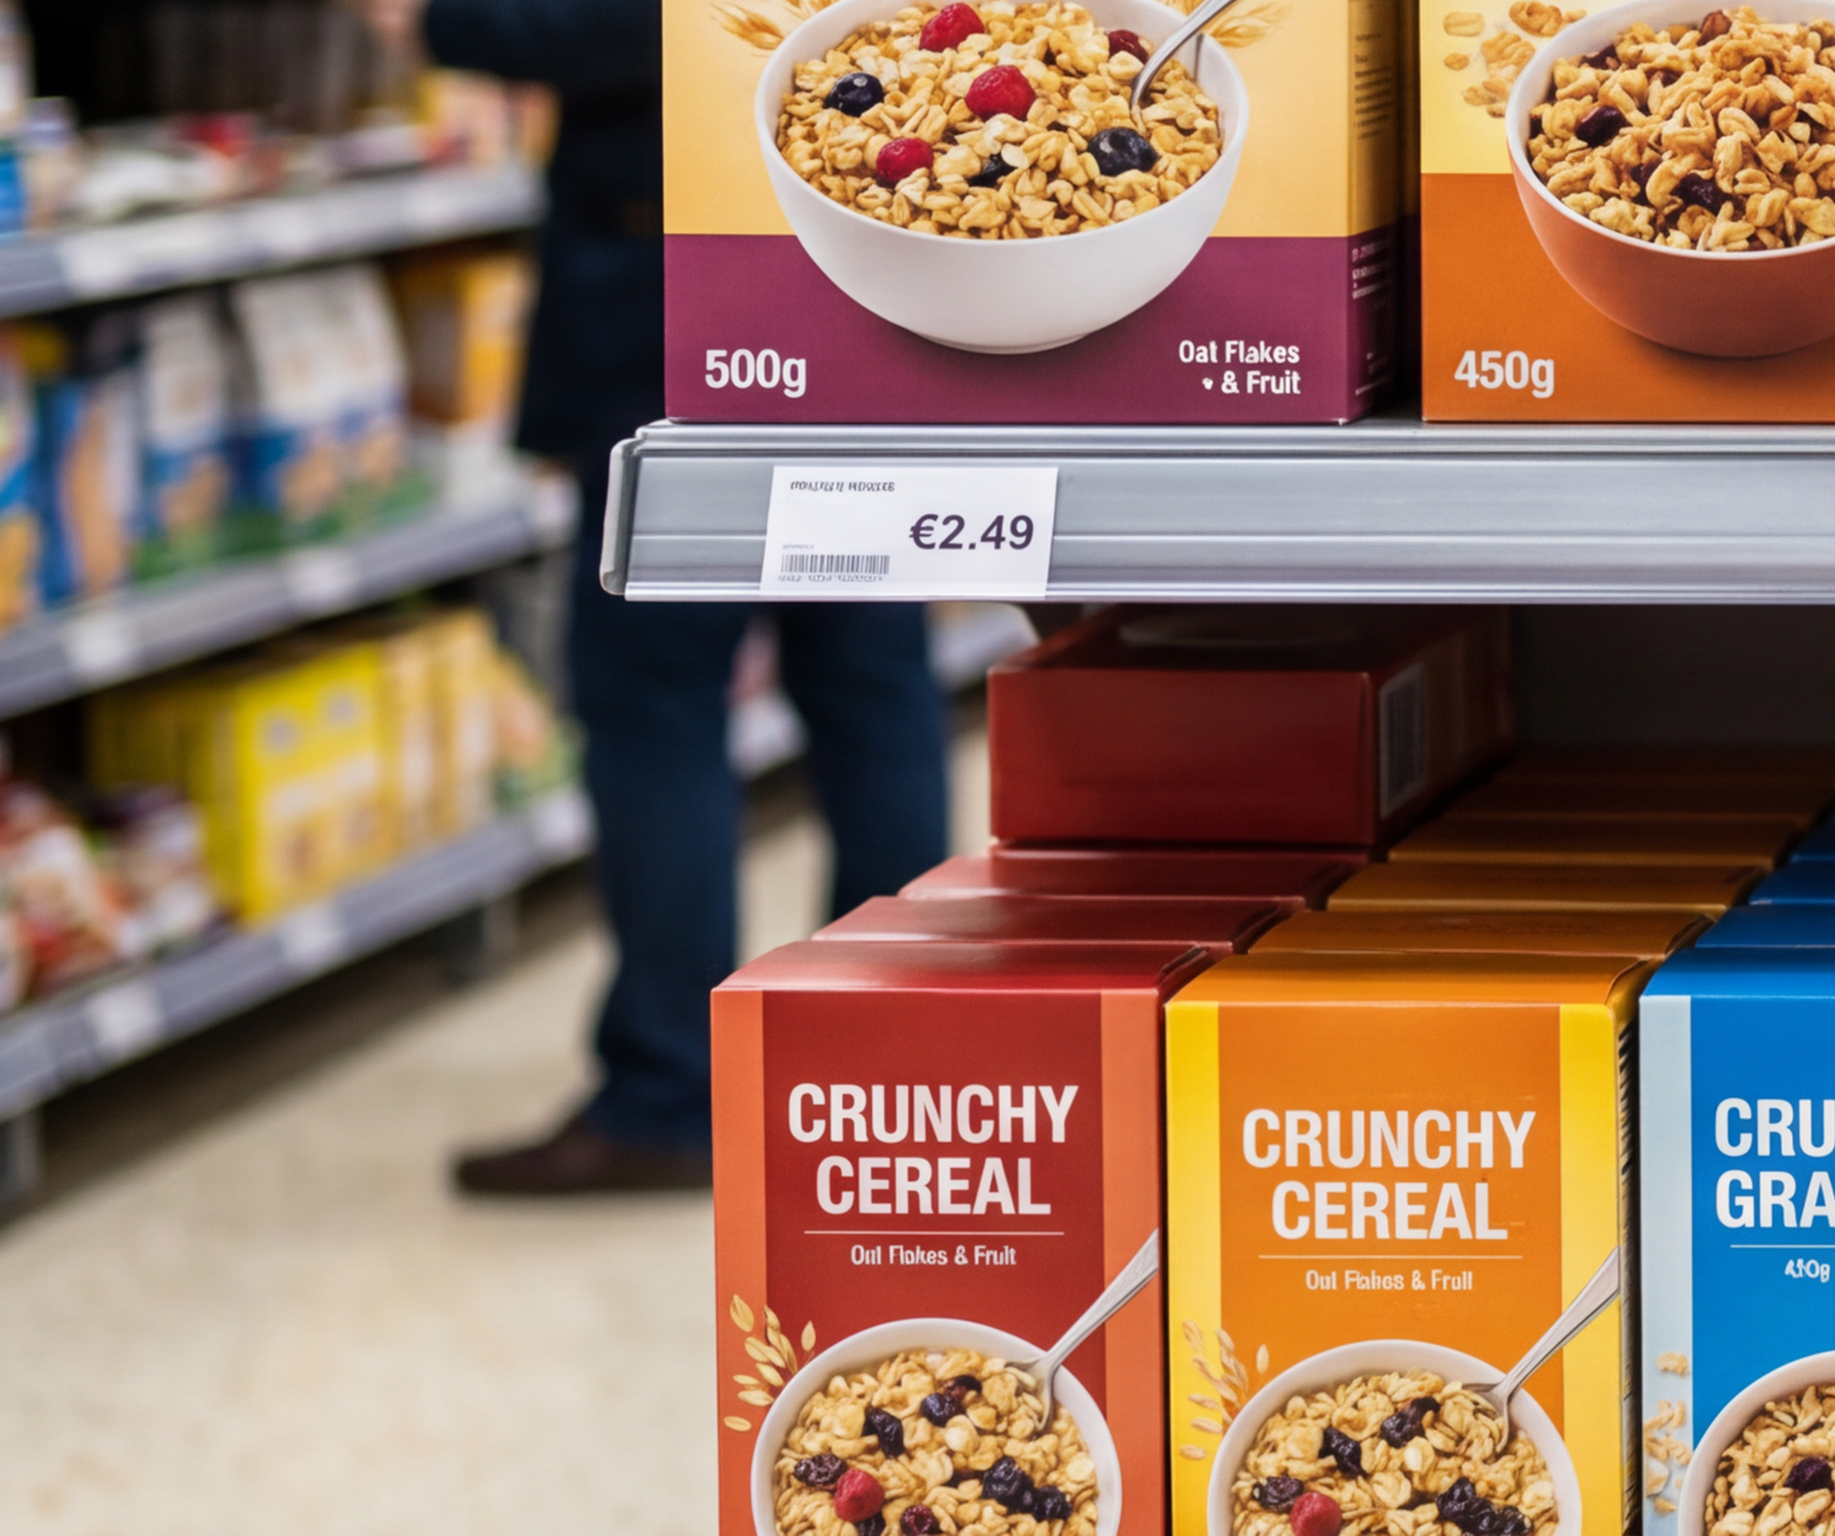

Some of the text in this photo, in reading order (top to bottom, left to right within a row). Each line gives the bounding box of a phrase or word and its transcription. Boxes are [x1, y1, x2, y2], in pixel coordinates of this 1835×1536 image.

[705, 348, 806, 398] 500g
[1178, 340, 1300, 364] Oat Flakes
[1454, 350, 1555, 398] 450g
[1221, 370, 1300, 395] & Fruit
[909, 513, 1034, 550] €2.49
[788, 1083, 1079, 1144] CRUNCHY
[1242, 1108, 1537, 1169] CRUNCHY
[816, 1155, 1051, 1215] CEREAL
[1271, 1180, 1508, 1240] CEREAL
